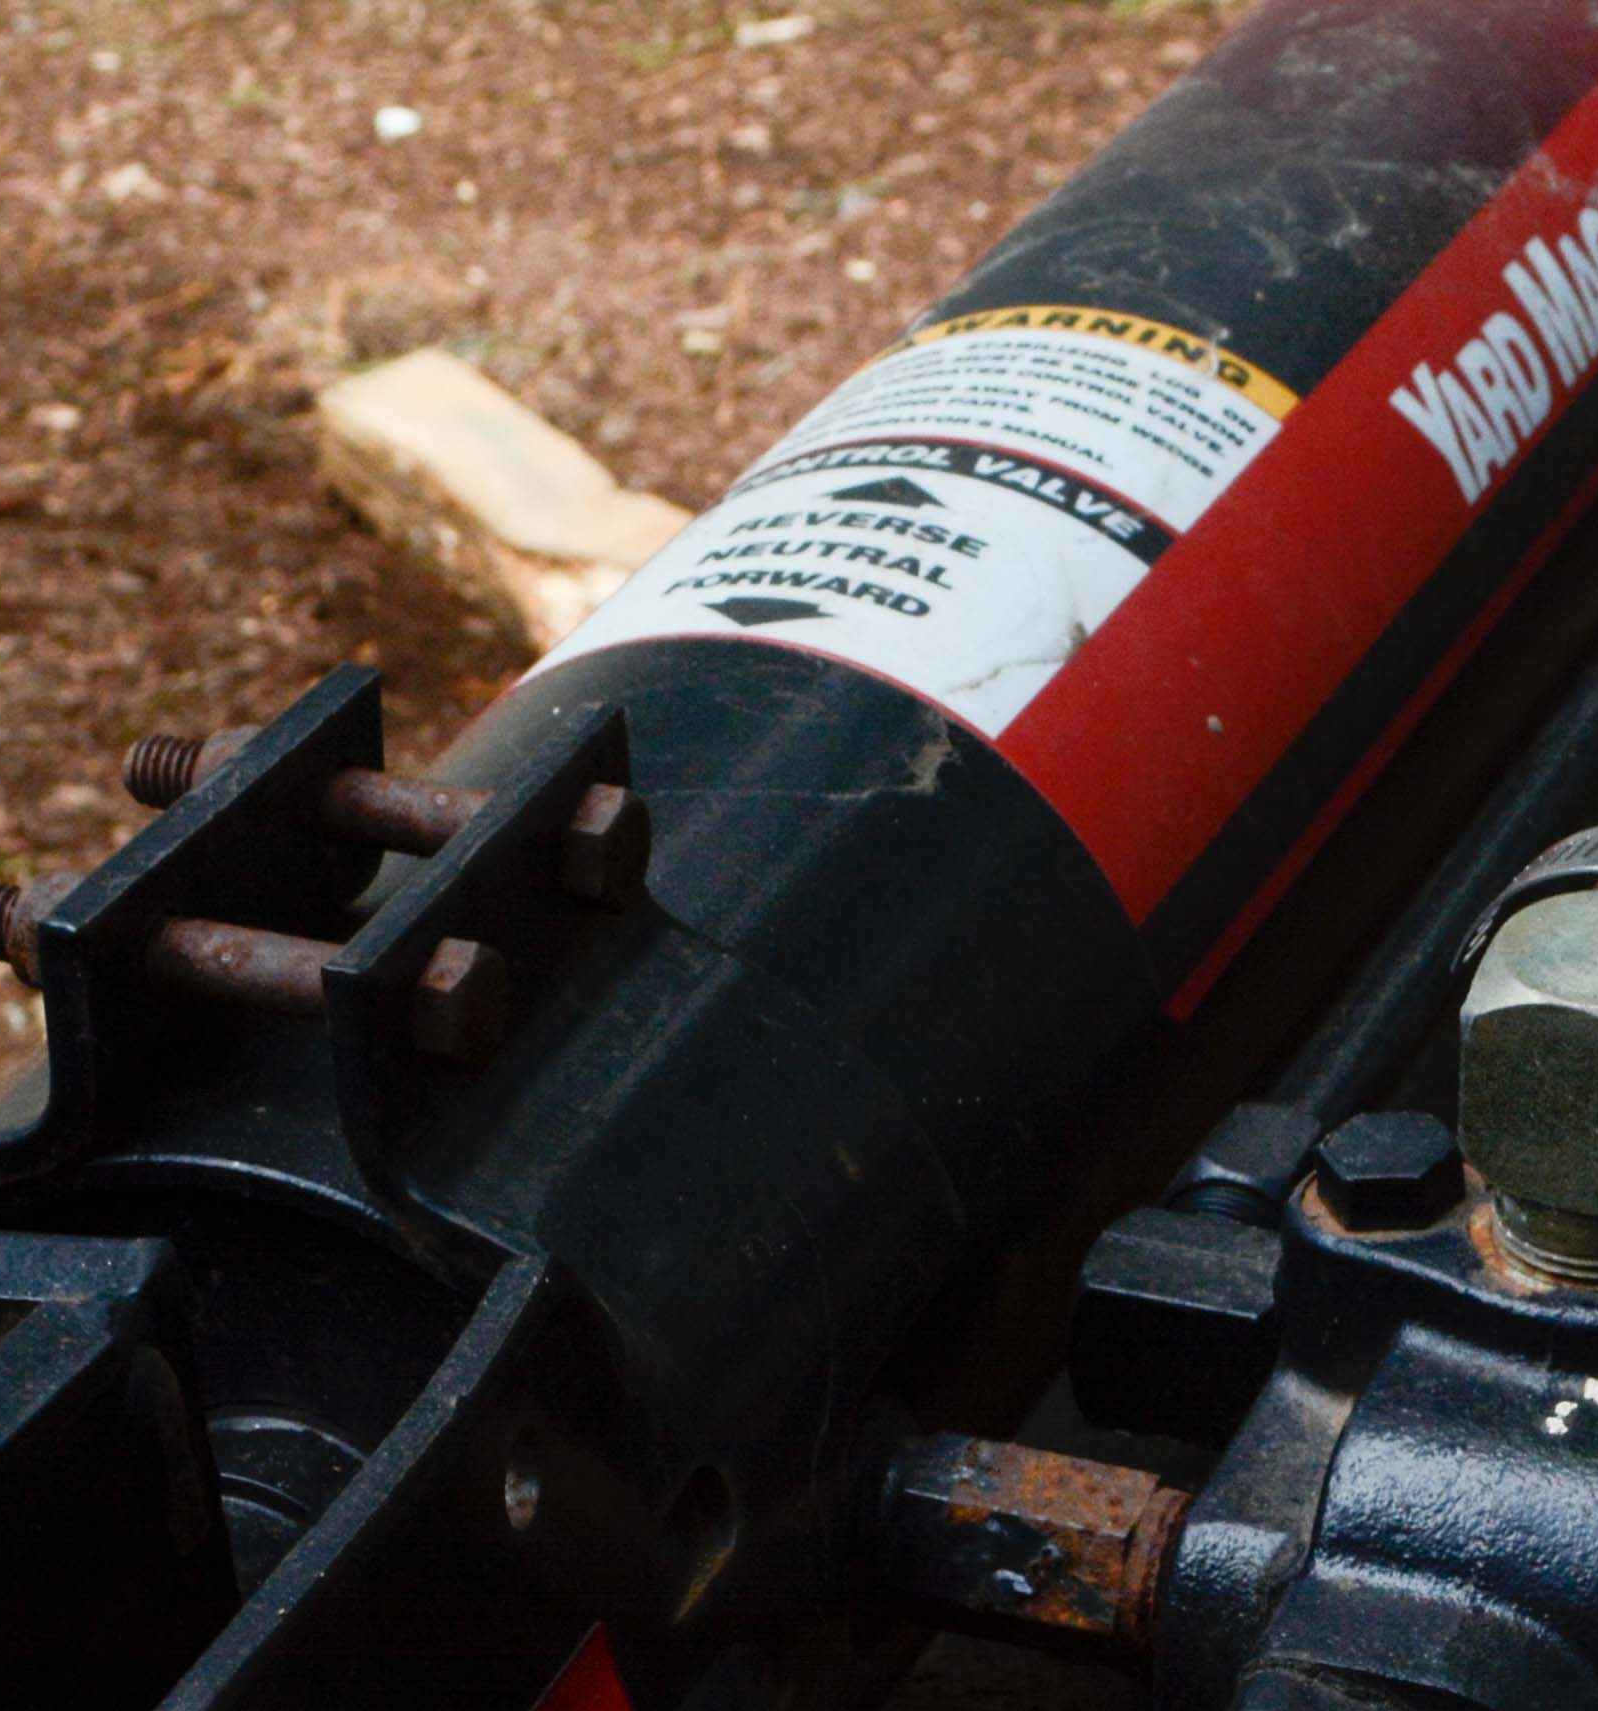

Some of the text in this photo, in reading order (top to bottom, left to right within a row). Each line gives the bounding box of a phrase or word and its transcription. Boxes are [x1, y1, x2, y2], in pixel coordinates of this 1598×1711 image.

[945, 311, 1250, 389] WARNING
[1017, 368, 1133, 406] CONTROL
[1030, 356, 1063, 369] BE
[1072, 363, 1140, 390] SAME
[1148, 387, 1246, 448] PERSON
[1150, 370, 1201, 400] LOG
[1222, 407, 1257, 435] ON
[1049, 395, 1121, 426] FROM
[1131, 424, 1215, 479] WEDGE
[1389, 361, 1553, 506] YARD
[973, 453, 1146, 540] VALVE
[698, 540, 955, 590] NEUTRAL
[727, 510, 991, 560] REVERSE
[662, 569, 932, 618] FORWARD
